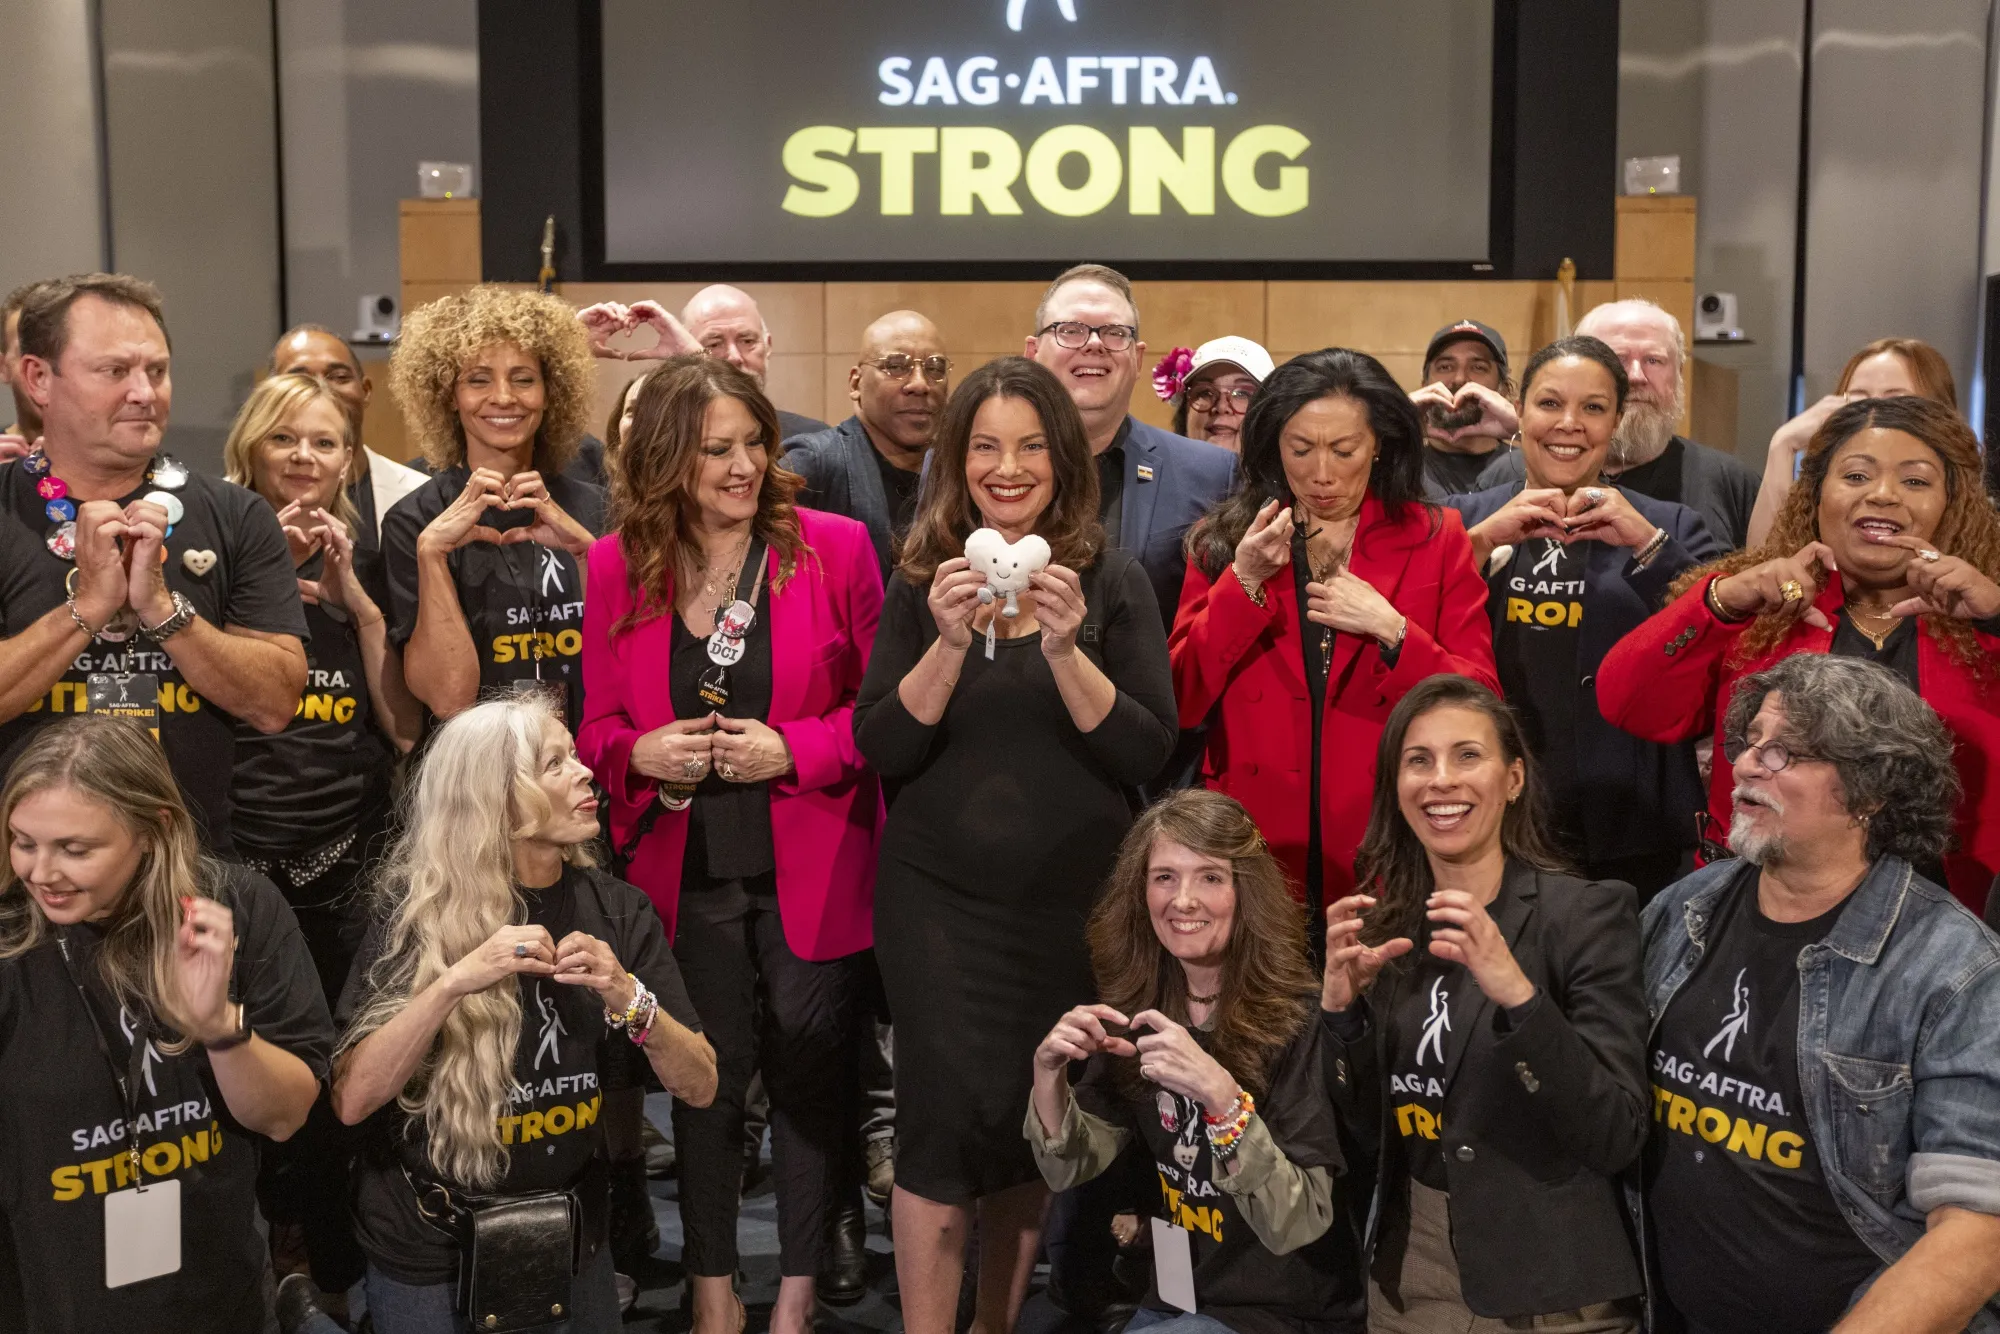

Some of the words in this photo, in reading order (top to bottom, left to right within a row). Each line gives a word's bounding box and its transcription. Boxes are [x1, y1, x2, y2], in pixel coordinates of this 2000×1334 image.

[781, 124, 1311, 217] STRONG
[492, 628, 583, 664] STRO
[710, 642, 738, 661] DCI
[113, 708, 155, 717] STRIKE!
[497, 1087, 602, 1145] TRON
[1652, 1084, 1806, 1169] TRONG
[51, 1120, 223, 1201] STRONG
